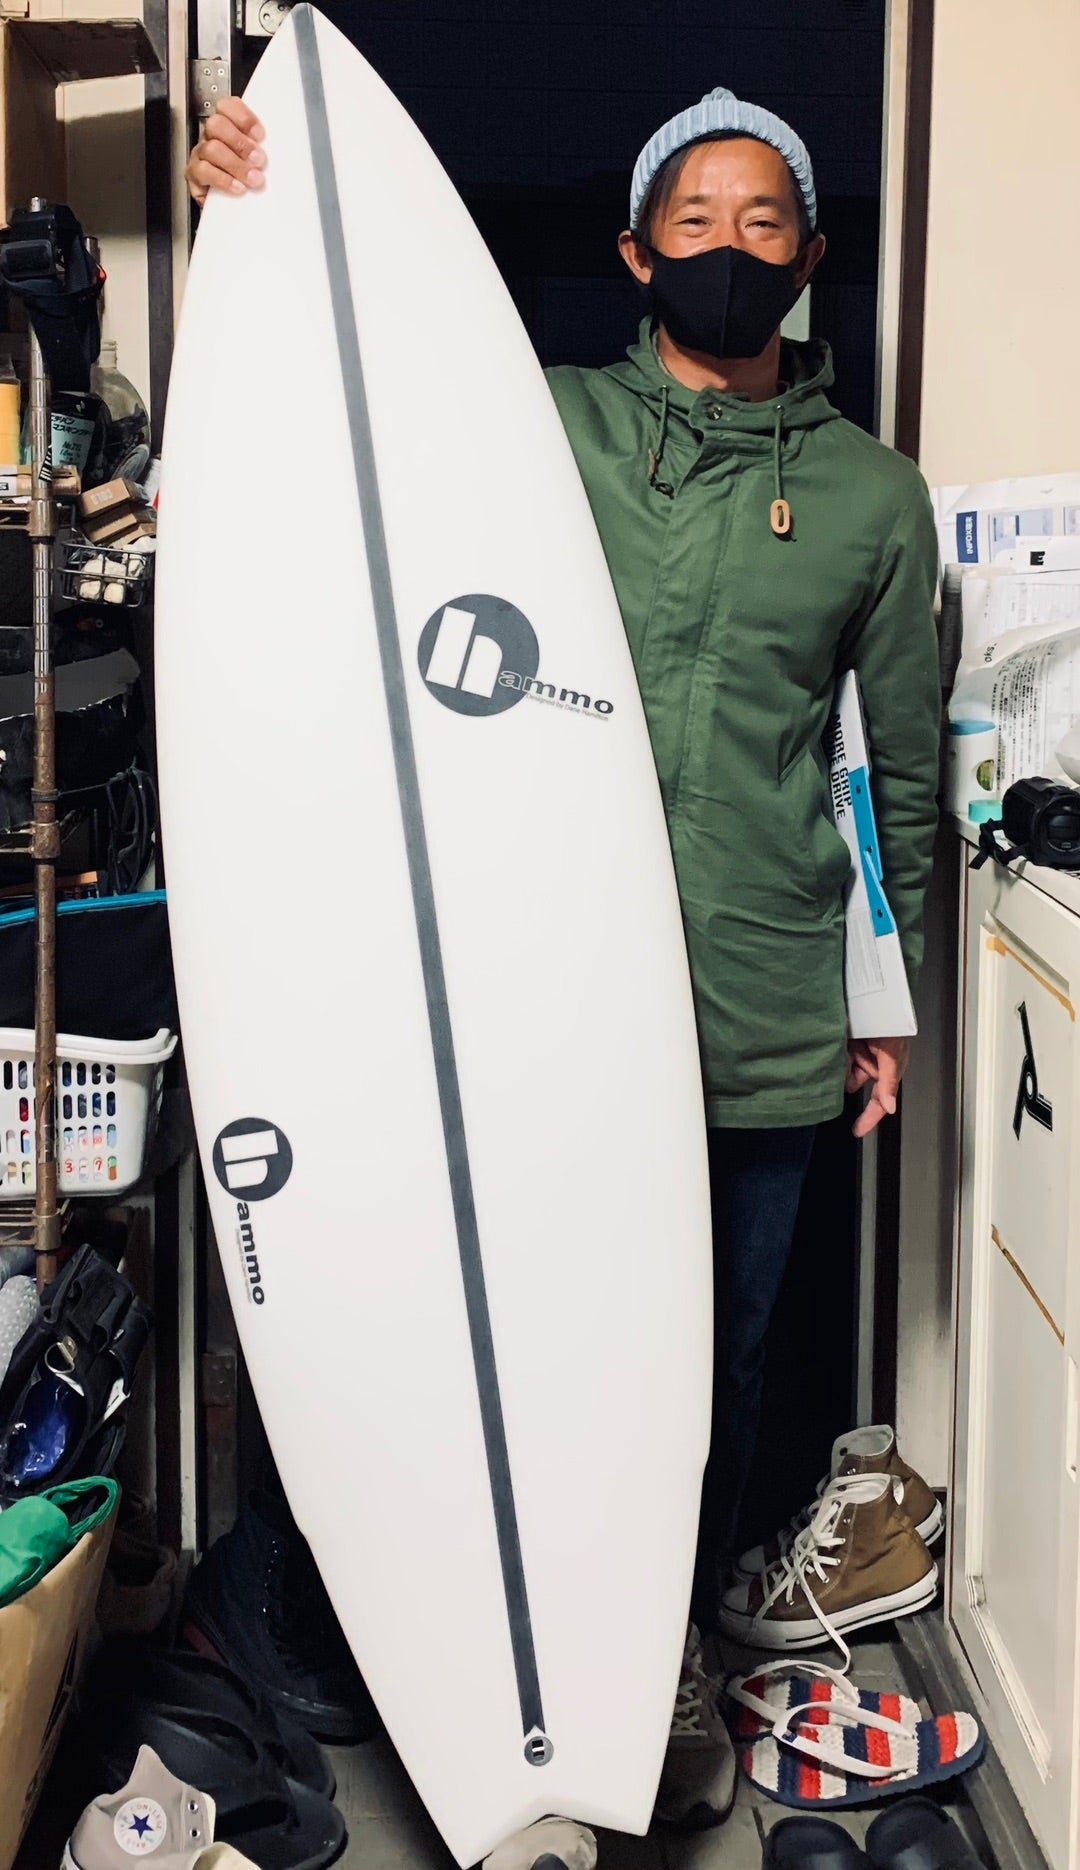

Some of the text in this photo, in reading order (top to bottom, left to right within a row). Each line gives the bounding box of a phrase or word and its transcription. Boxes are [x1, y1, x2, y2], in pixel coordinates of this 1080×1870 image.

[832, 713, 852, 806] MORE GRIP
[831, 771, 846, 820] DRIVE
